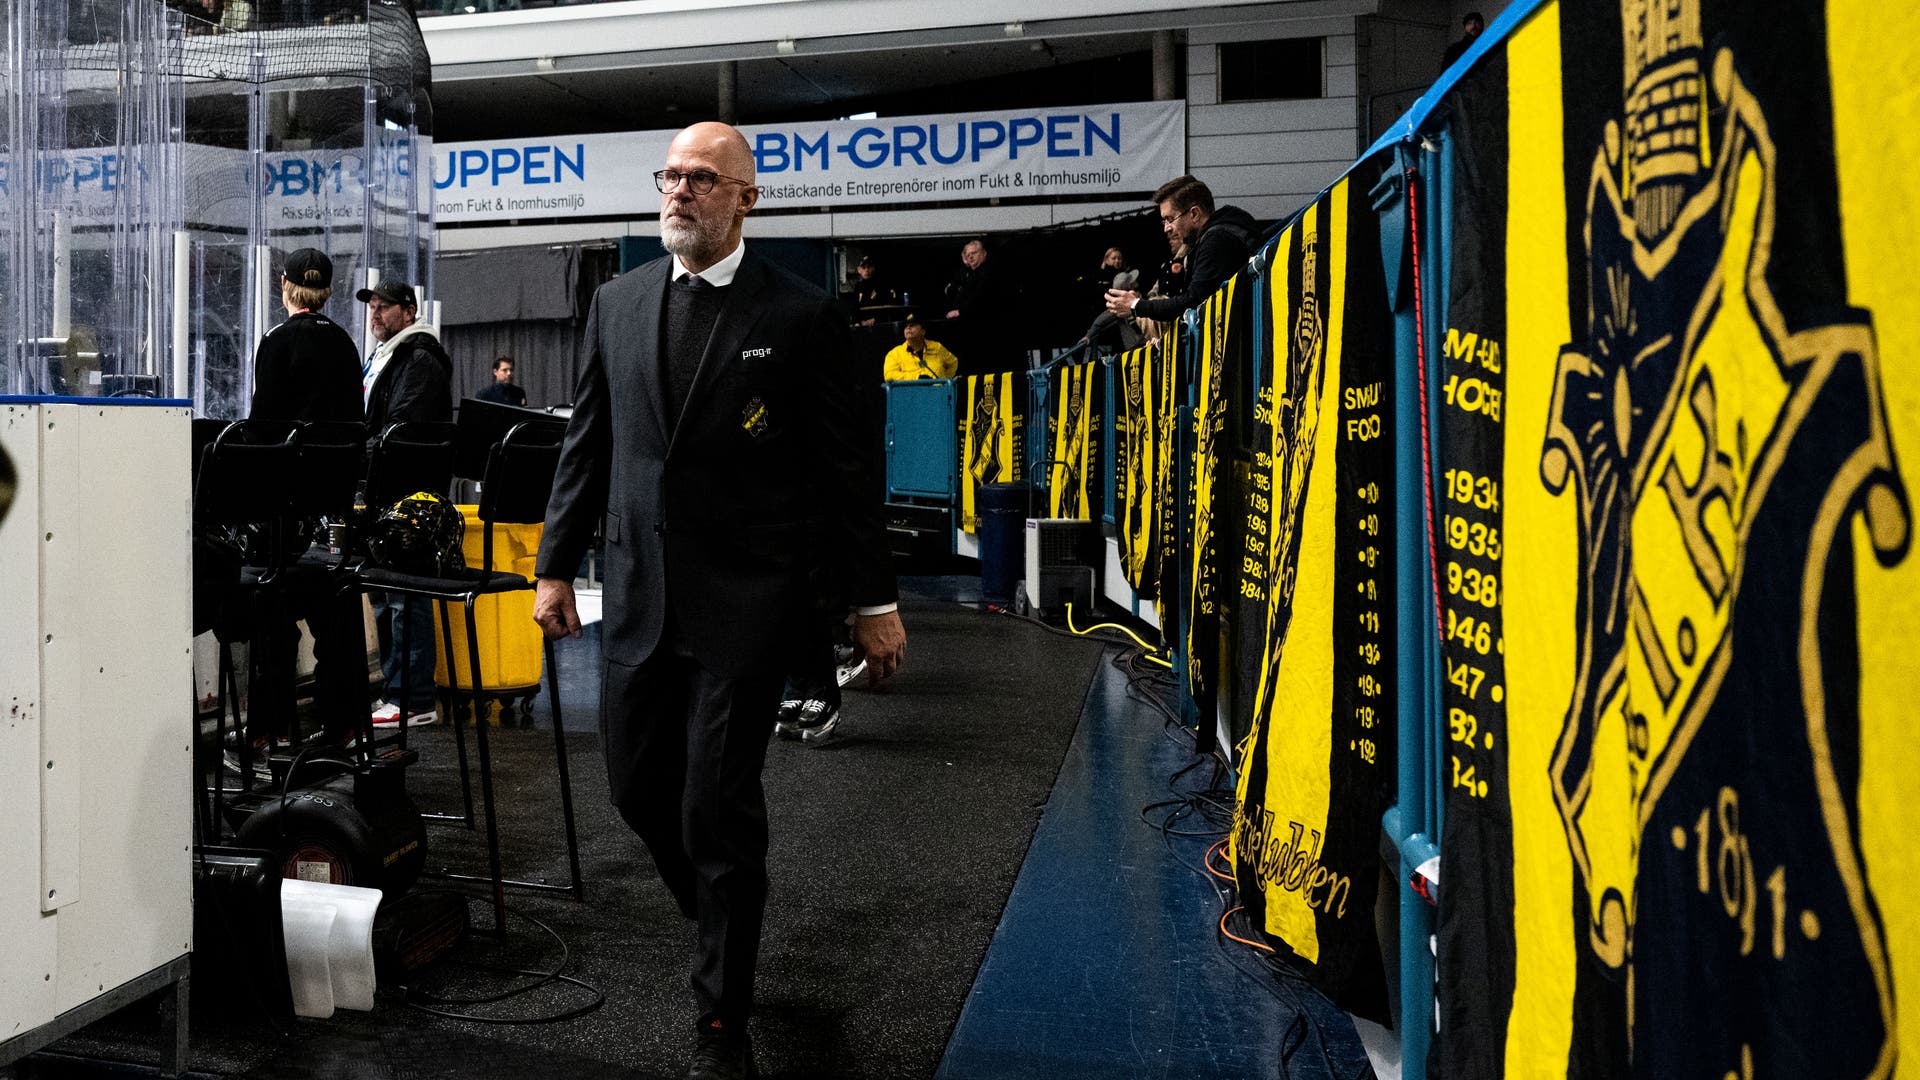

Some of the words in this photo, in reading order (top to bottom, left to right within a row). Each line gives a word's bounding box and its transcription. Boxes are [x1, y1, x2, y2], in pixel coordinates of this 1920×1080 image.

[846, 176, 938, 196] Entreprenörer
[942, 175, 976, 191] inom
[980, 173, 1010, 189] Fukt
[1014, 172, 1024, 187] &
[1028, 168, 1121, 188] Inomhusmiljö
[467, 198, 492, 213] Fukt
[496, 199, 504, 211] &
[507, 192, 585, 211] Inomhusmiljö
